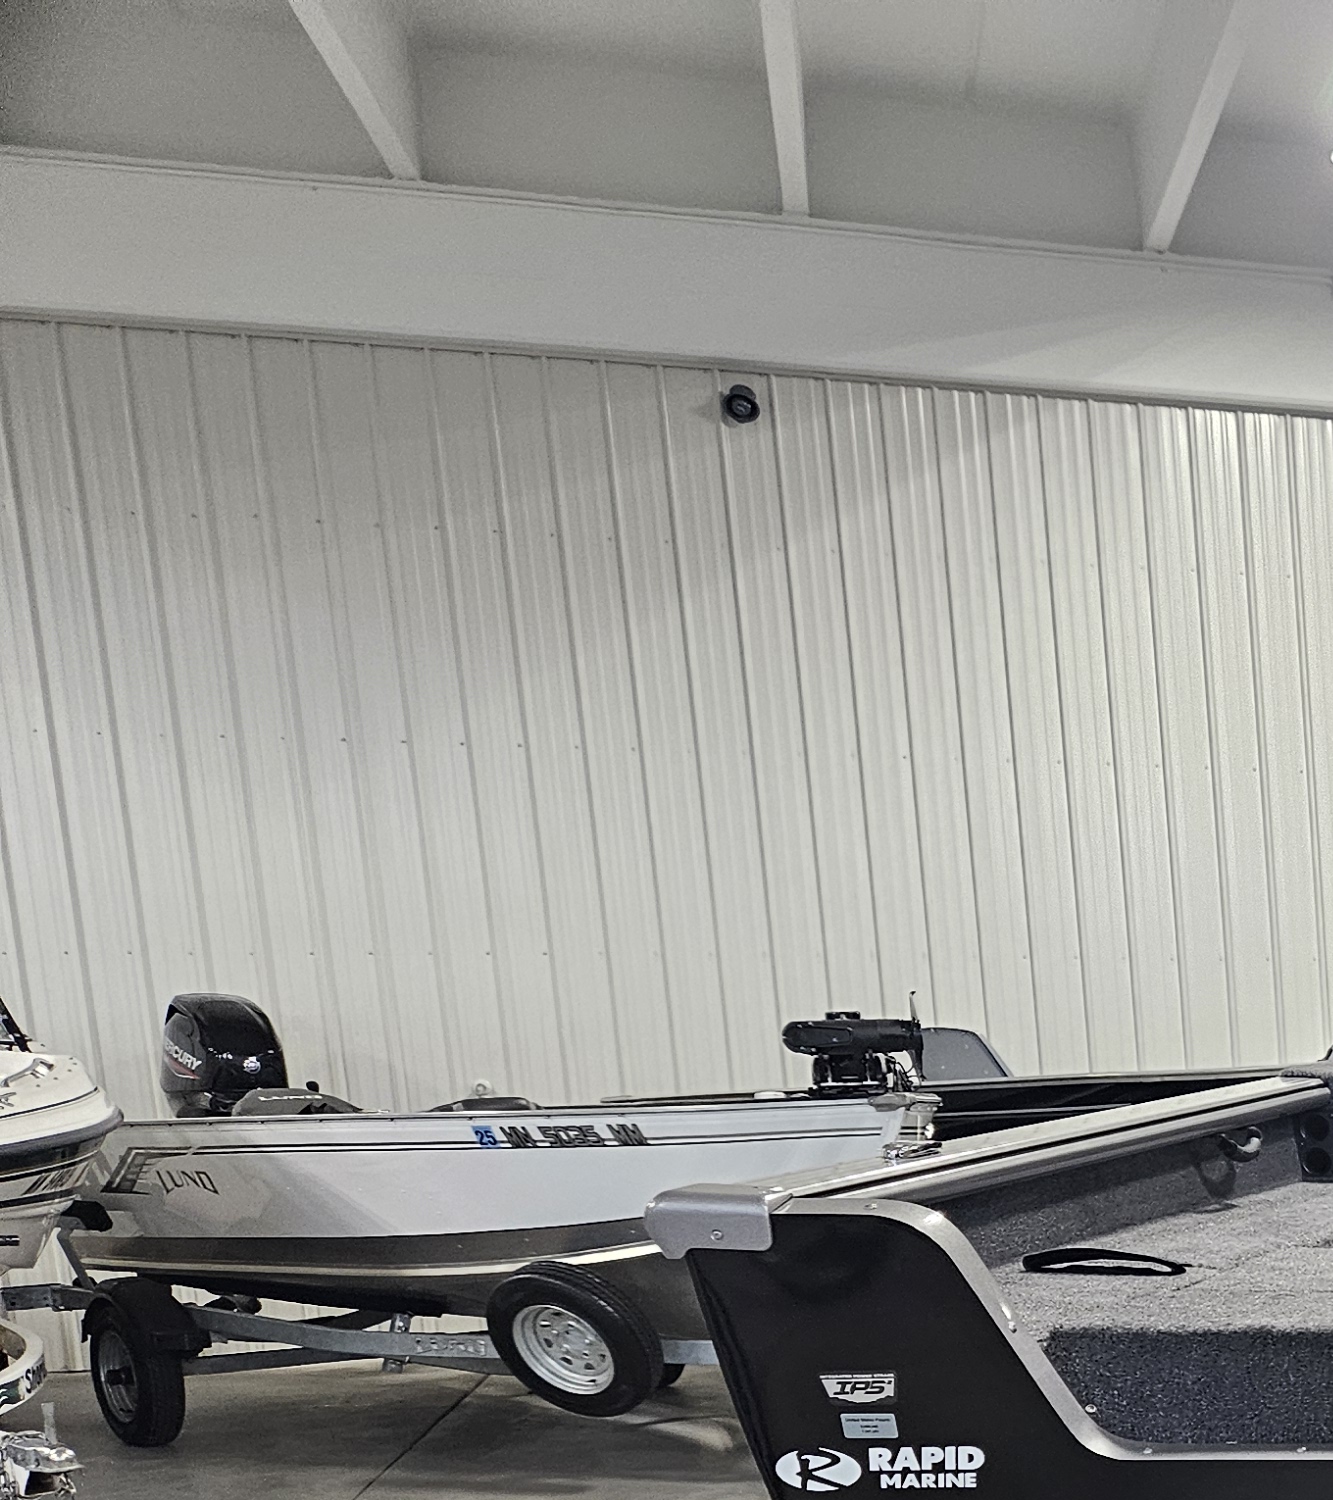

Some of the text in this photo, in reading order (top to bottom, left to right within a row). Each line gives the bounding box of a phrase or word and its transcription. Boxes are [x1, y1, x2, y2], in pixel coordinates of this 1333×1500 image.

[475, 1130, 497, 1146] 25
[500, 1126, 538, 1148] MN
[156, 1170, 220, 1195] LUND
[868, 1446, 985, 1472] RAPID
[880, 1473, 977, 1489] MARINE
